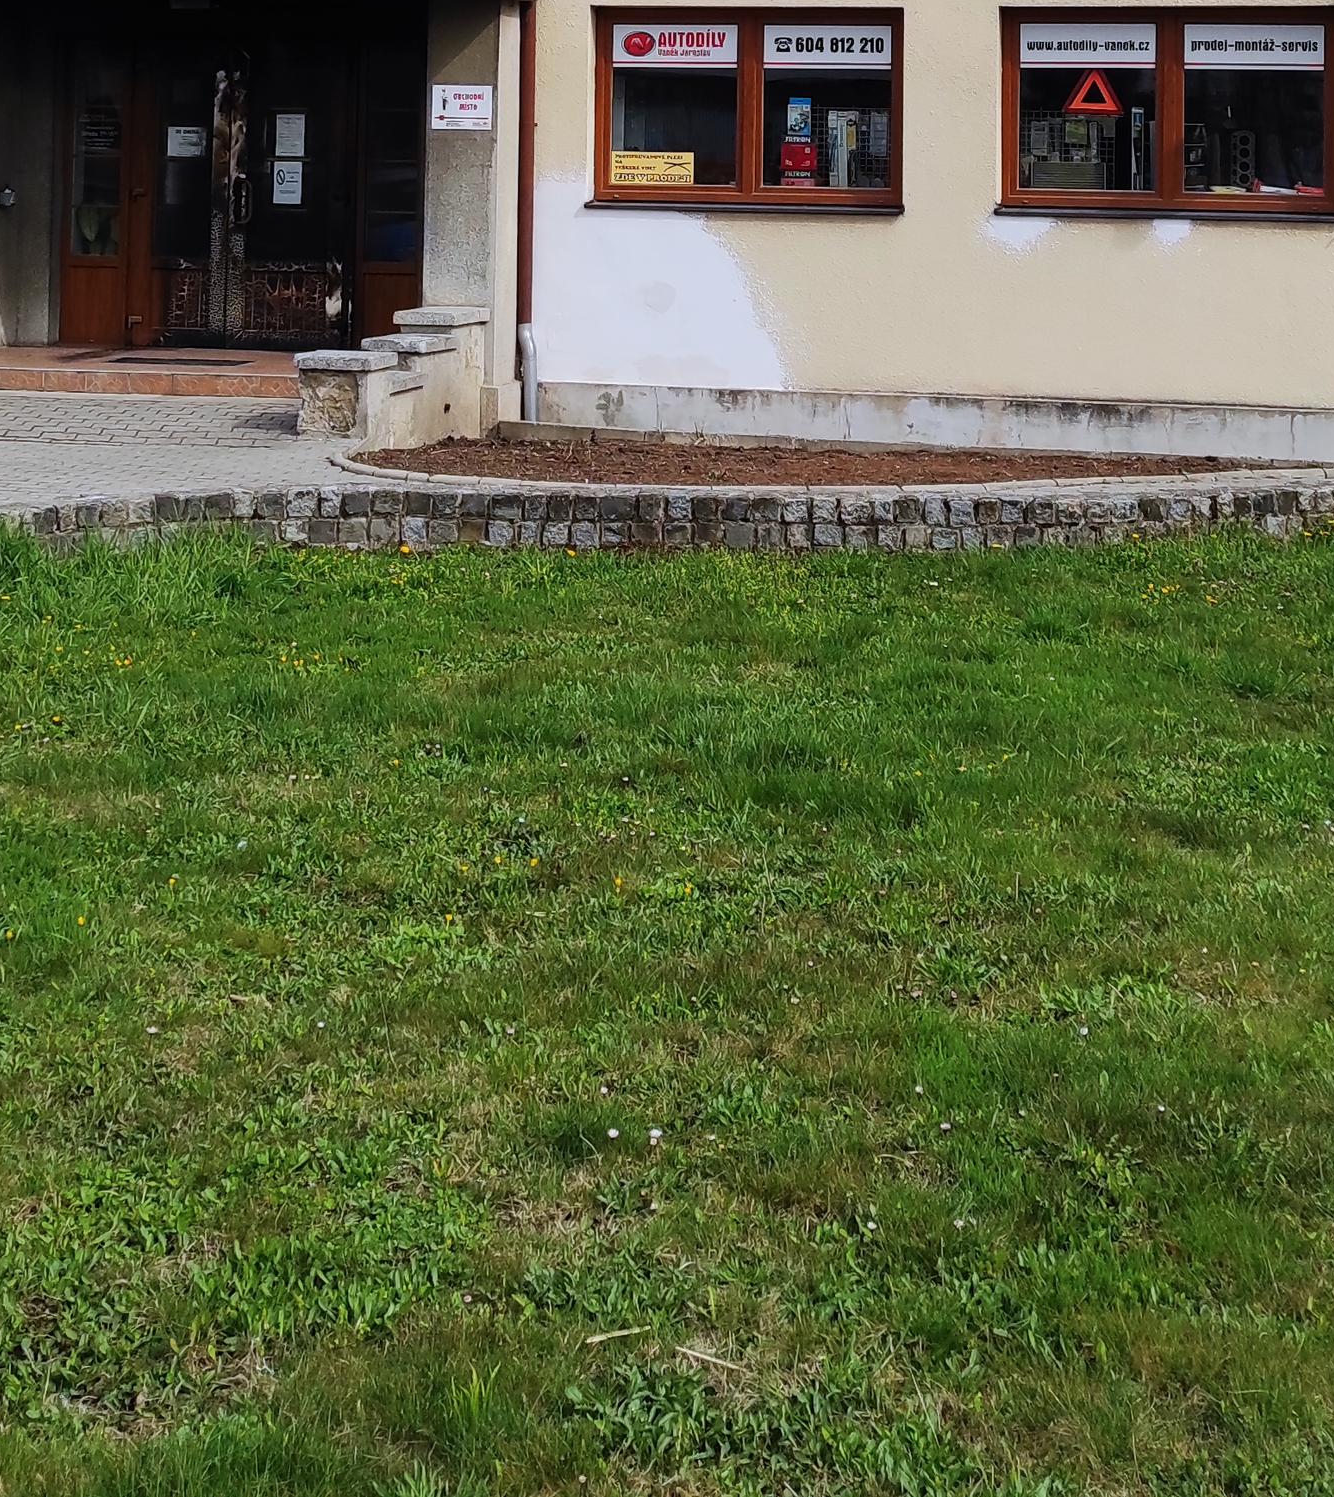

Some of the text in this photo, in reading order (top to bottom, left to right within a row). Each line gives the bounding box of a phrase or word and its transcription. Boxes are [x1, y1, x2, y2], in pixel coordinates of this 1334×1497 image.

[658, 29, 726, 48] AUTODÍLY
[795, 36, 885, 54] 604 812 210
[1191, 38, 1318, 53] prodej-montáž-servis
[614, 172, 691, 183] ZDE V PRODEJI
